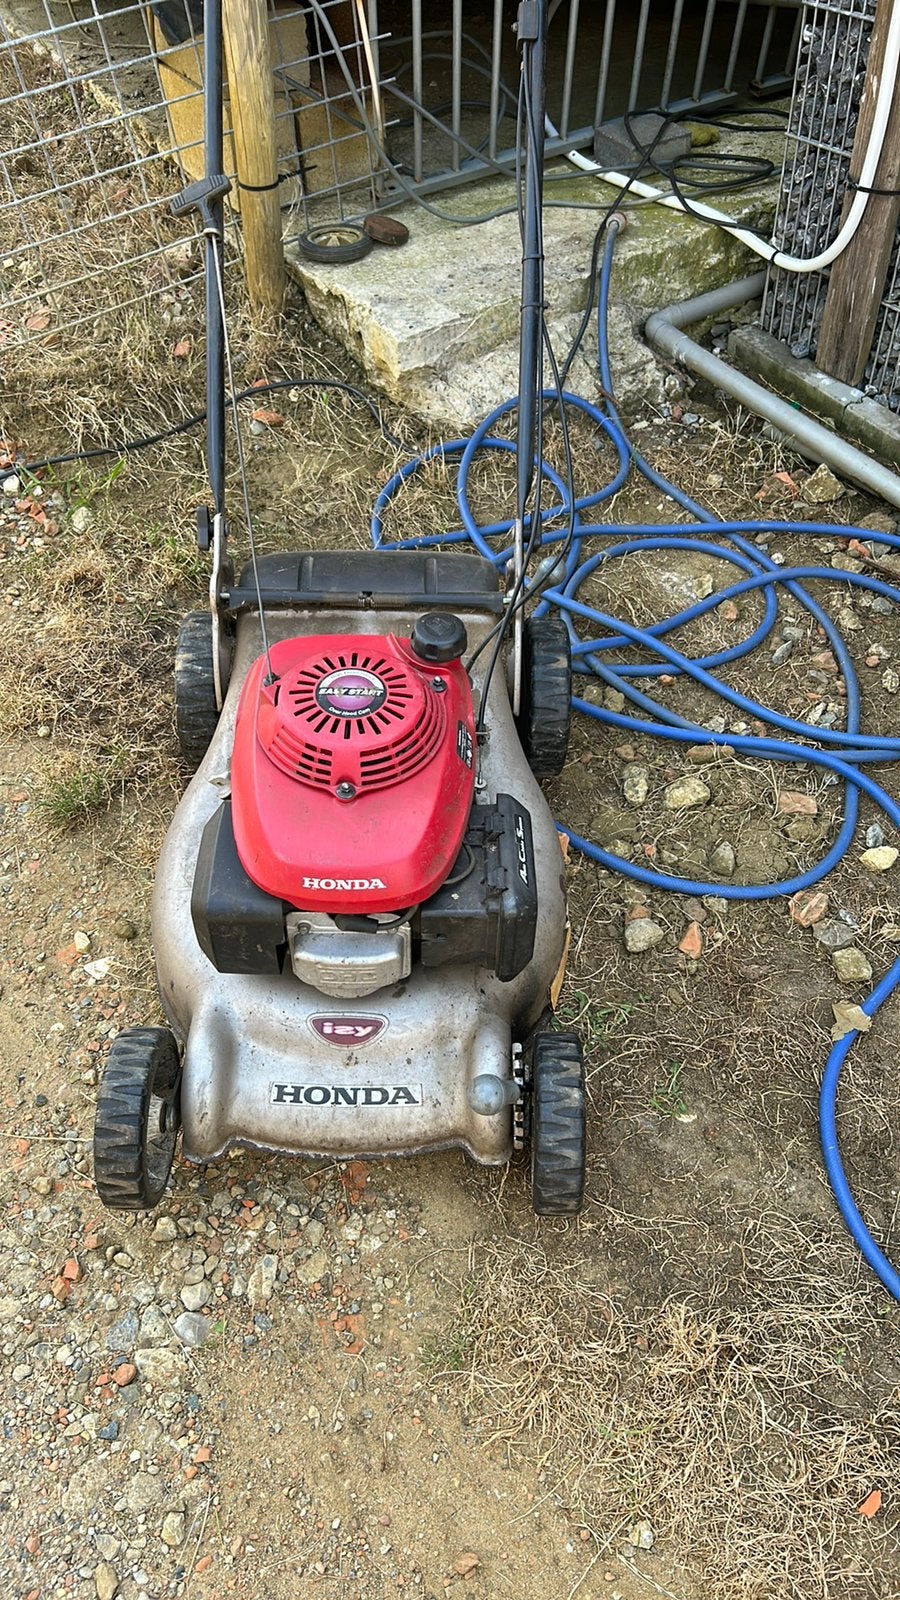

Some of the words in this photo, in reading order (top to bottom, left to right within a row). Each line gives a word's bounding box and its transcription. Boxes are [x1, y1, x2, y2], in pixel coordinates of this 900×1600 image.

[348, 688, 384, 697] START
[302, 877, 387, 890] HONDA
[322, 1022, 373, 1037] izy
[272, 1084, 420, 1105] HONDA
